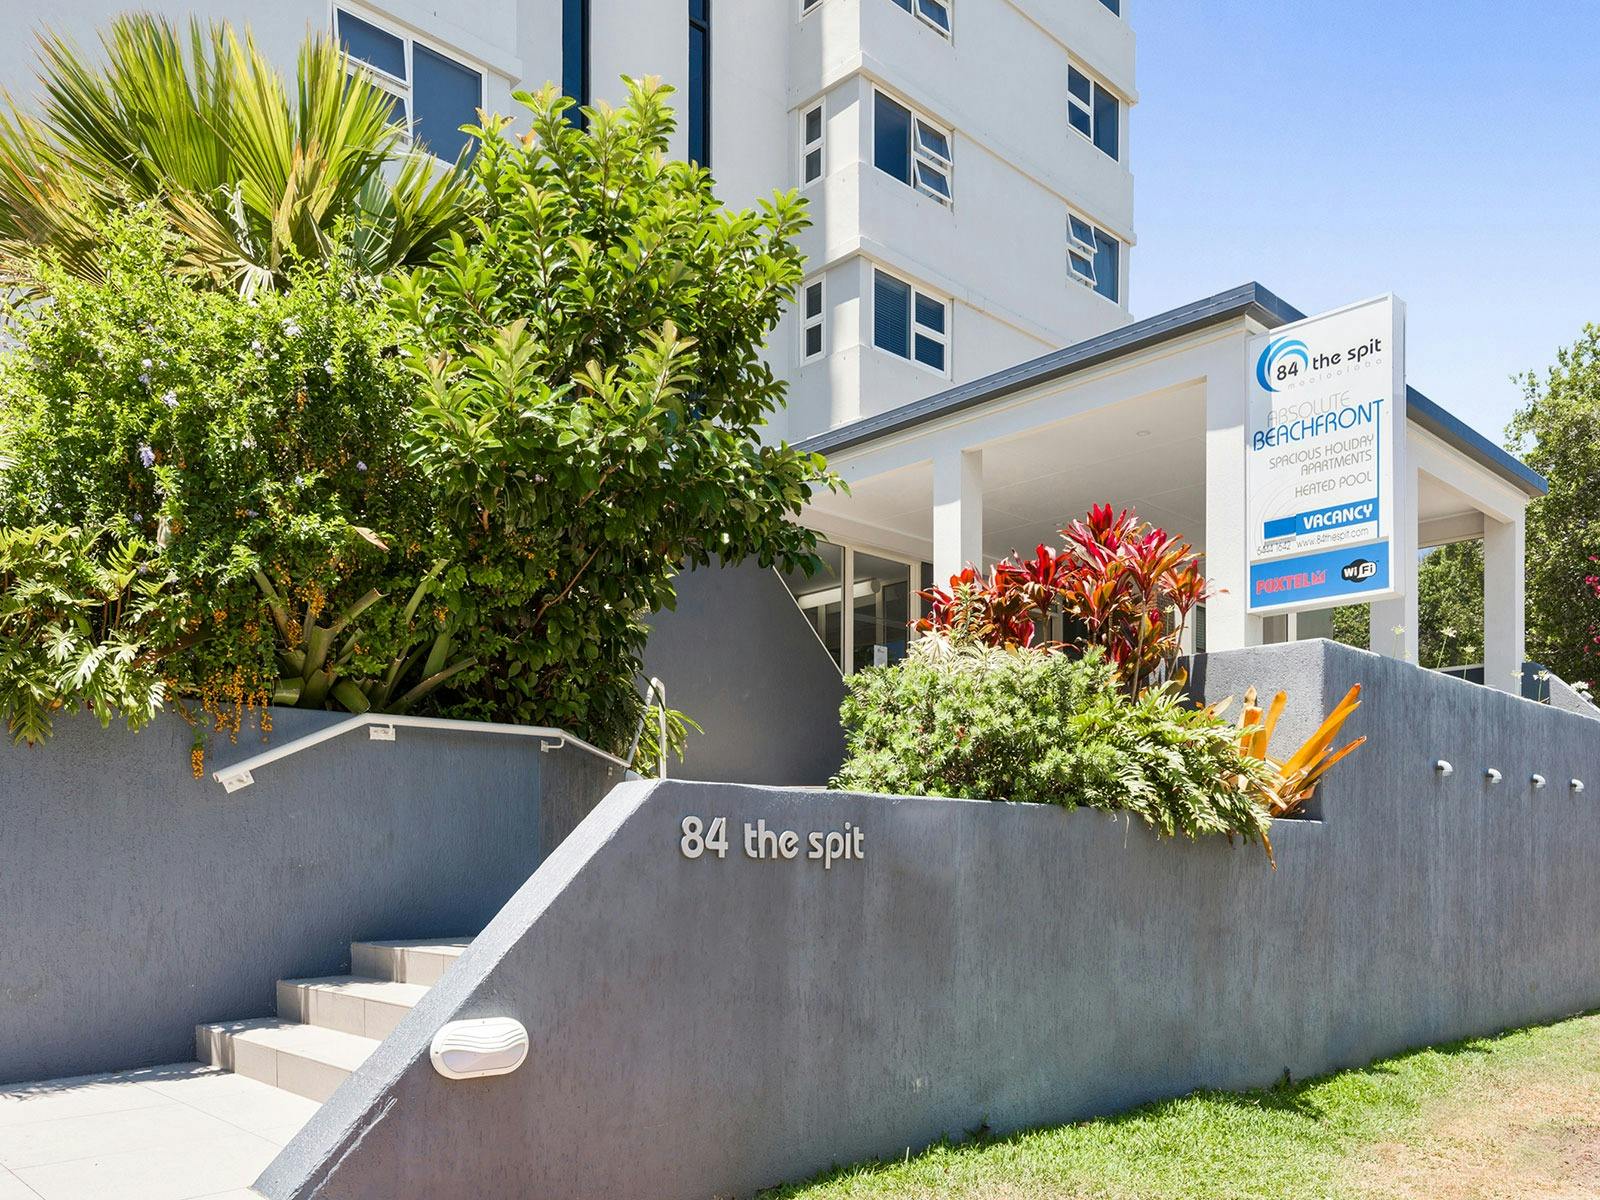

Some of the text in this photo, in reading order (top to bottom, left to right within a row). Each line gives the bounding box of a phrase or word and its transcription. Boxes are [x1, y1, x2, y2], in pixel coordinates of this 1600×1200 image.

[1277, 338, 1382, 381] 84 the spit
[1253, 399, 1385, 452] BEACHFRONT
[1267, 390, 1351, 427] ABSOLUTE
[1269, 433, 1374, 470] SPACIOUS HOLIDAY
[1300, 449, 1372, 476] APARTMENTS
[1295, 471, 1372, 498] HEATED POOL
[1303, 503, 1374, 530] VACANCY
[681, 815, 865, 870] 84 the spit
